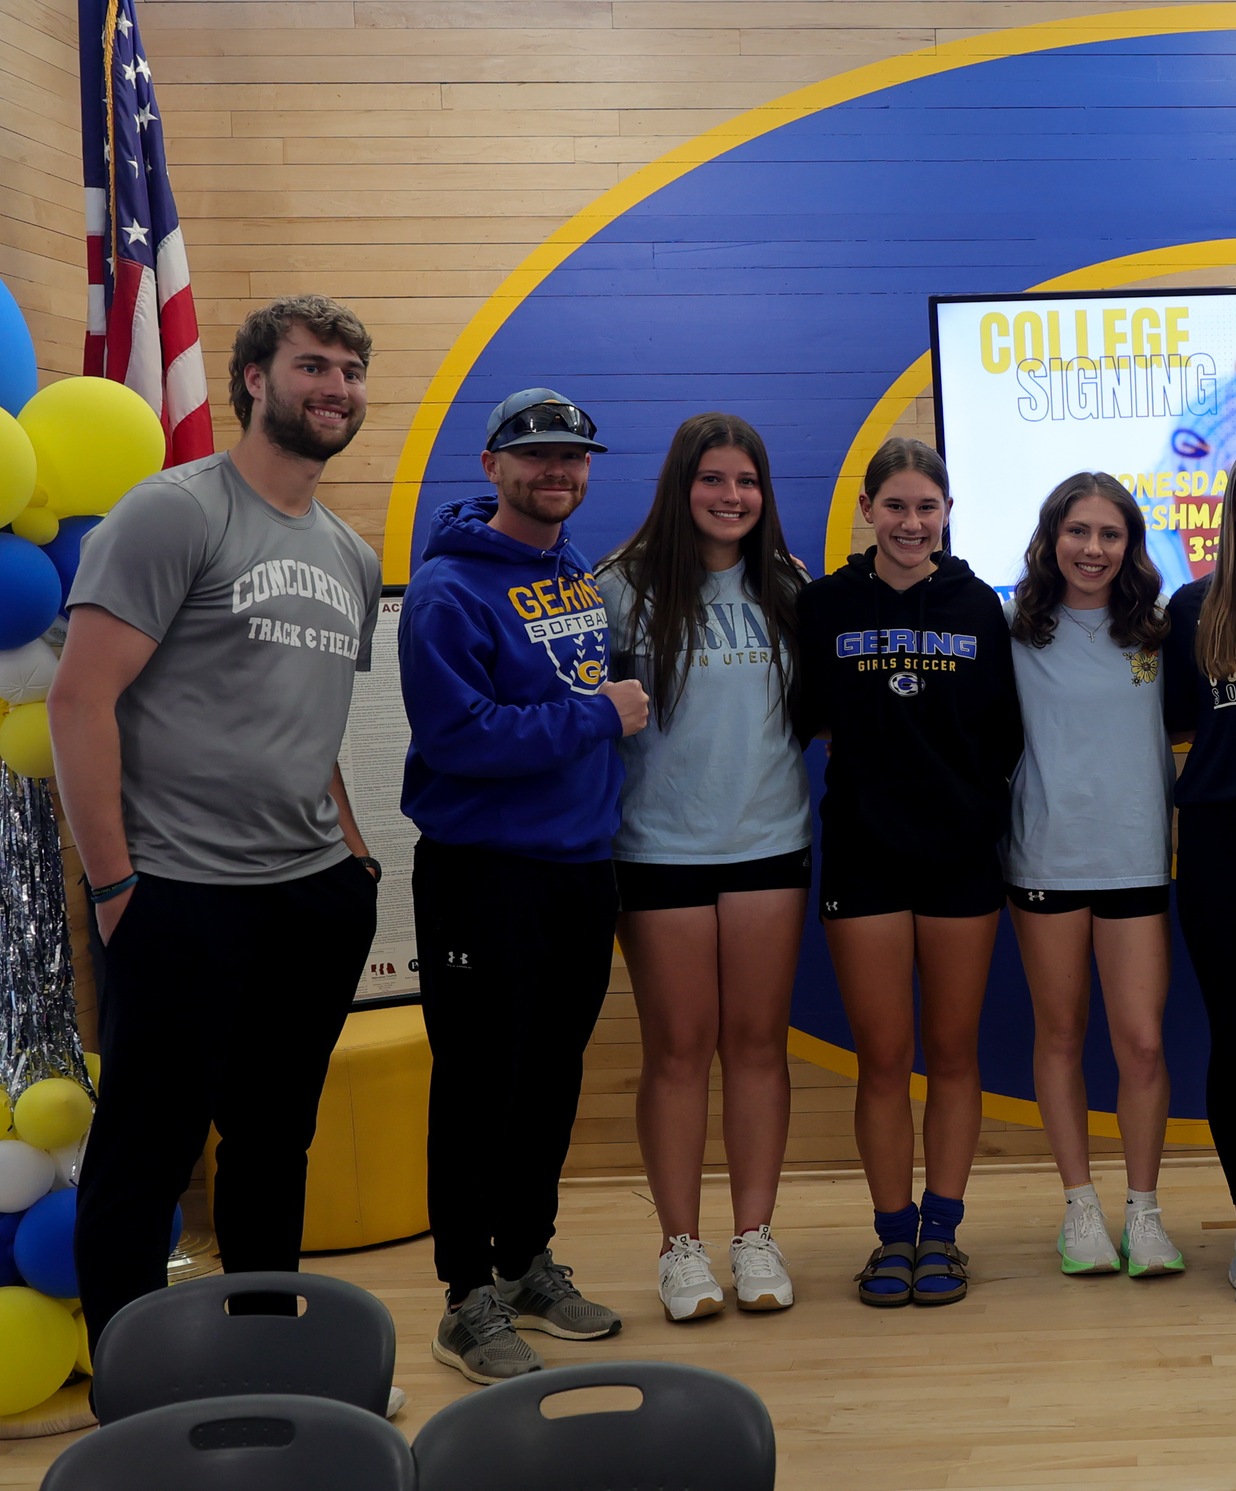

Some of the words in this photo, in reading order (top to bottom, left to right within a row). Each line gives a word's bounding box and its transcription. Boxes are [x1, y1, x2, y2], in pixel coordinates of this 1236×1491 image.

[980, 307, 1191, 374] COLLEGE
[1016, 353, 1218, 422] SIGNING
[1112, 469, 1229, 499] DNESDA
[248, 617, 301, 647] TRACK
[319, 629, 360, 661] FIELD
[836, 628, 977, 660] GERING
[723, 651, 769, 666] UTER
[858, 658, 897, 672] GIRLS
